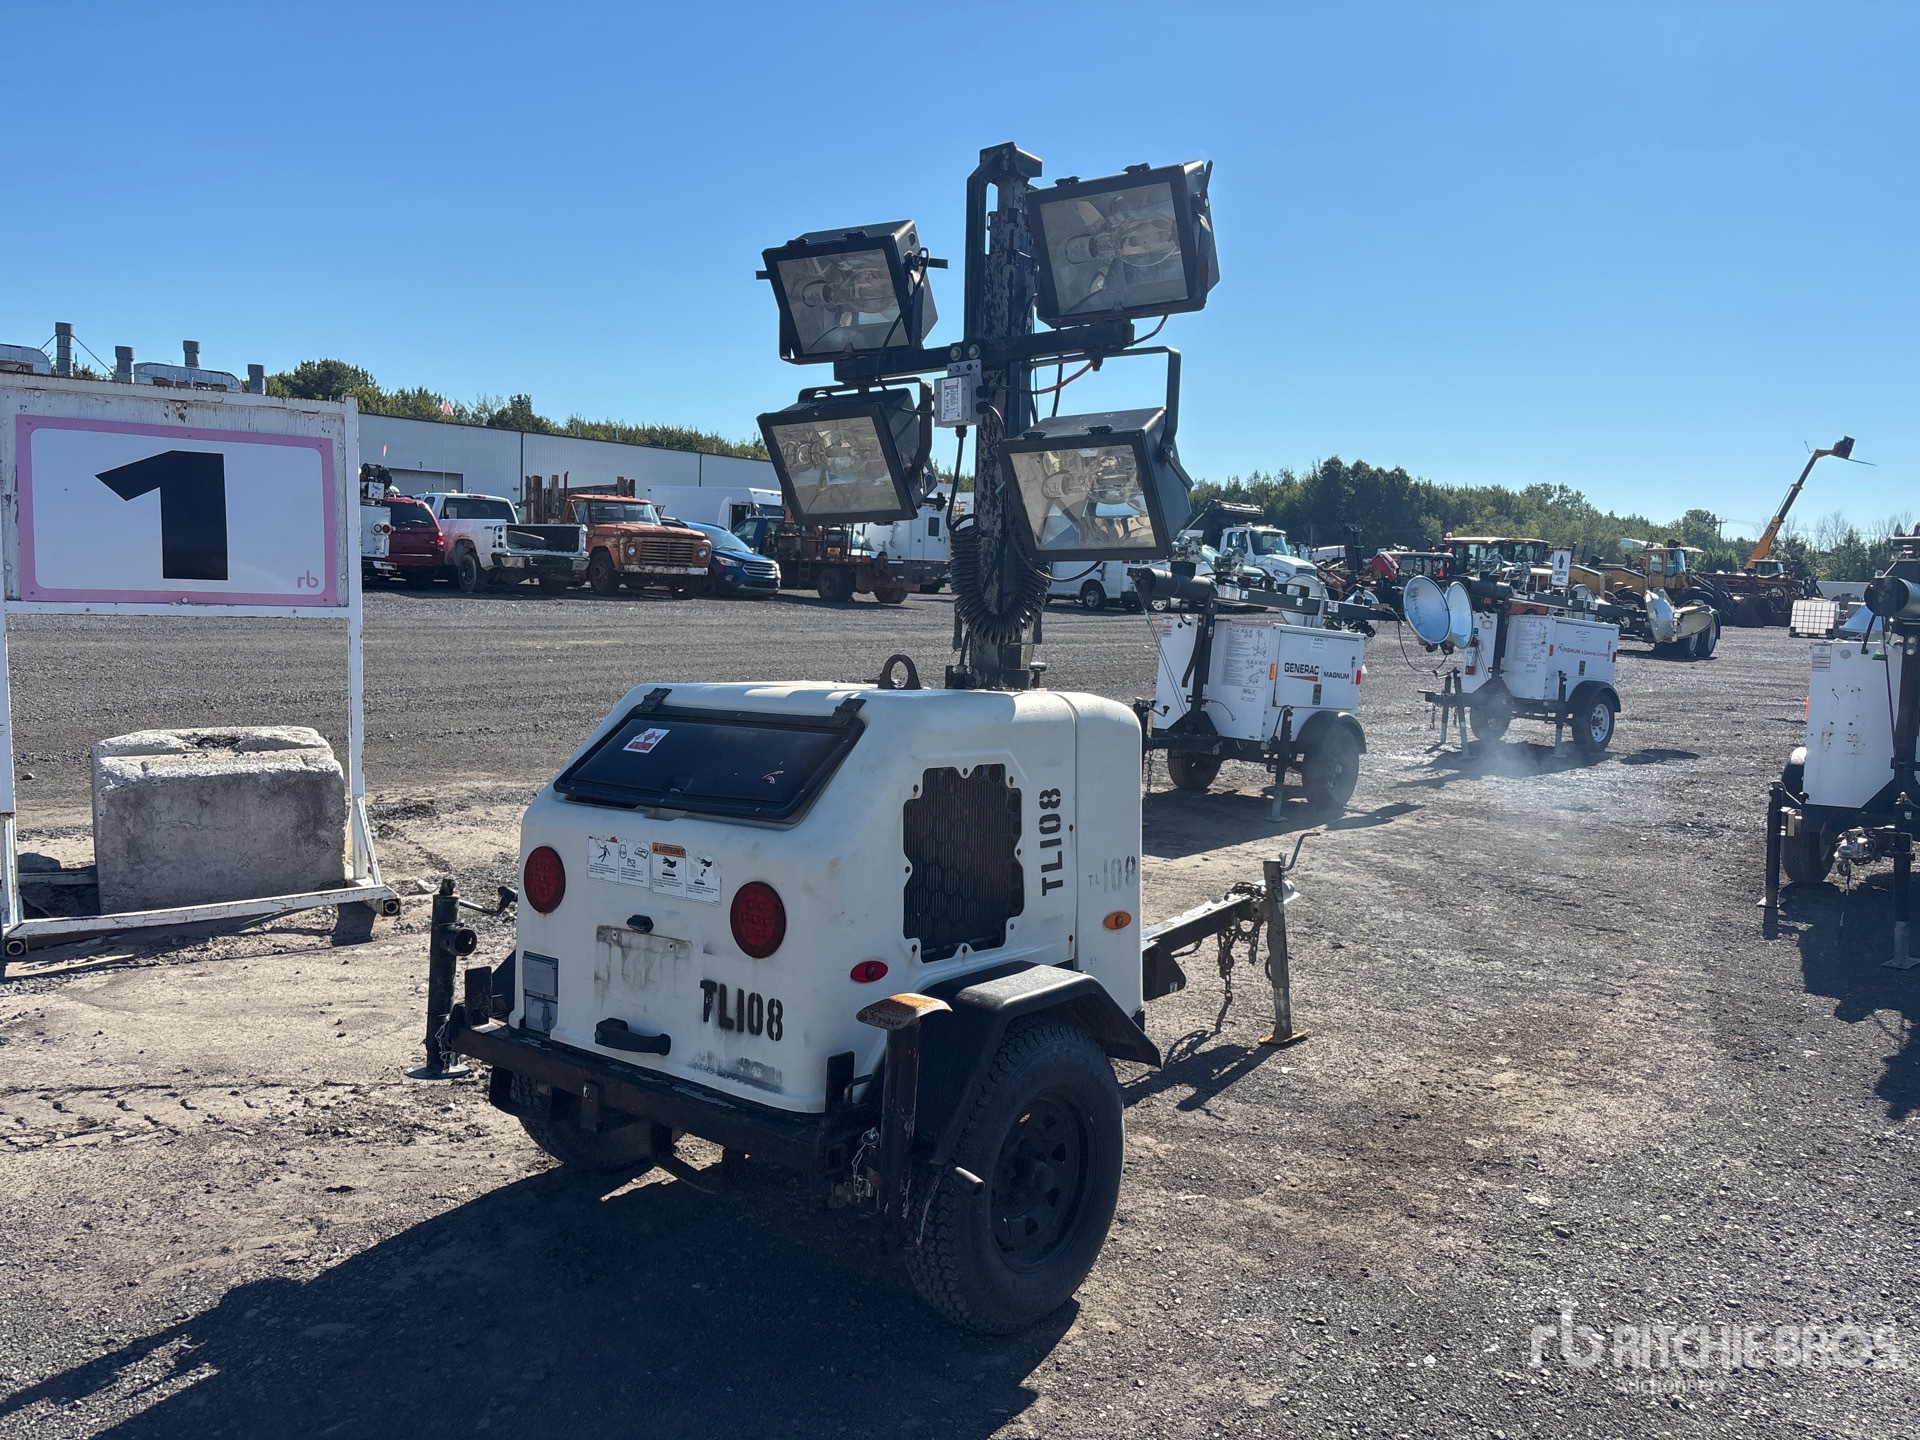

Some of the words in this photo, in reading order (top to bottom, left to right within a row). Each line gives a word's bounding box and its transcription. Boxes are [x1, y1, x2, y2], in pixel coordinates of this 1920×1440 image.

[418, 461, 423, 469] 3
[94, 450, 229, 581] 1
[297, 570, 319, 589] rb
[1284, 661, 1320, 676] GENERAC
[1323, 671, 1350, 680] MAGNUM
[1039, 788, 1064, 897] TL108
[700, 979, 784, 1042] TL108
